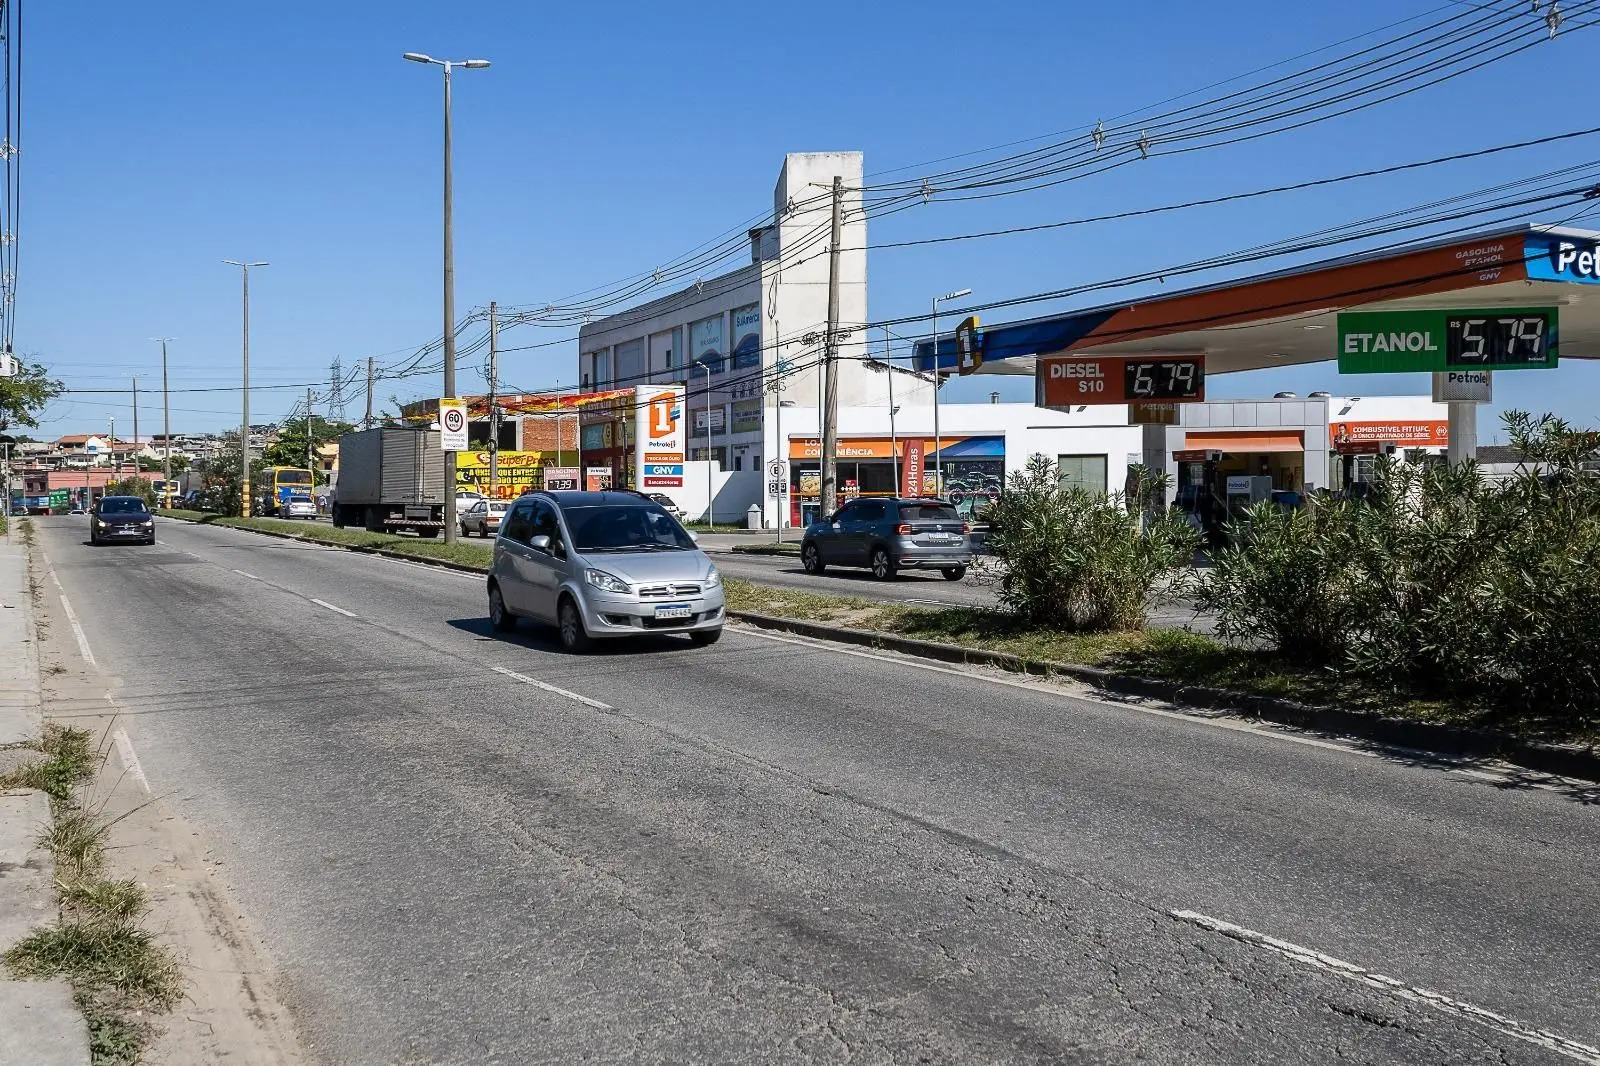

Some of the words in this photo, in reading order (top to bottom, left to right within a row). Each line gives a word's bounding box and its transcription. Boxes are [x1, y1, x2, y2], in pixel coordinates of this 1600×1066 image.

[1455, 244, 1504, 259] GASOLINA
[1464, 254, 1503, 266] ETANOL
[1479, 271, 1501, 281] GNV
[1344, 331, 1438, 353] ETANOL
[1461, 319, 1544, 361] 5,79
[1050, 363, 1105, 379] DIESEL
[1079, 380, 1104, 393] S10
[1134, 363, 1195, 397] 6,79
[448, 413, 460, 423] 60
[1352, 425, 1400, 433] COMBUSTÍVEL
[653, 466, 675, 474] GNV
